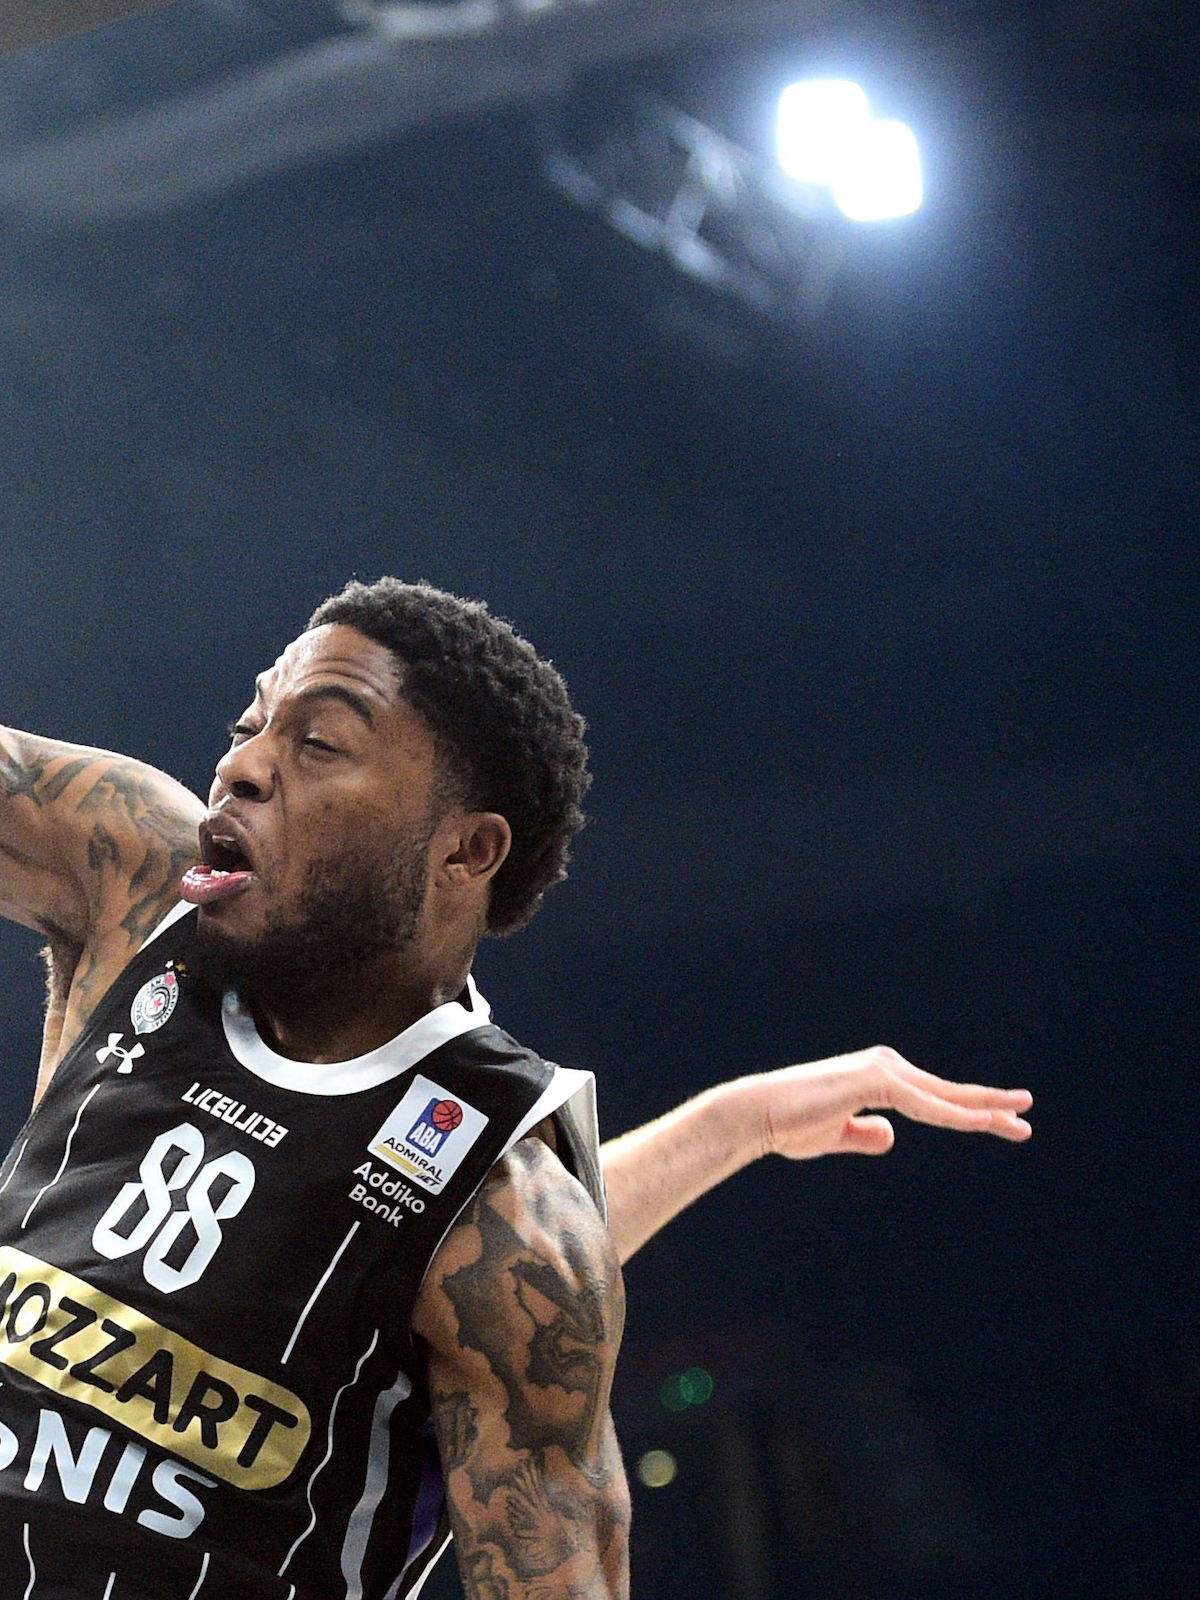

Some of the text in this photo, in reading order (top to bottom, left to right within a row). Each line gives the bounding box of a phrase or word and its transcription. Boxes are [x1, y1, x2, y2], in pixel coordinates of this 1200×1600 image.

[383, 1137, 443, 1180] ADMIRAL
[409, 1122, 443, 1154] ABA
[92, 1122, 255, 1294] 88
[348, 1183, 404, 1228] Bank
[353, 1161, 426, 1213] Addiko
[23, 1409, 220, 1540] NIS
